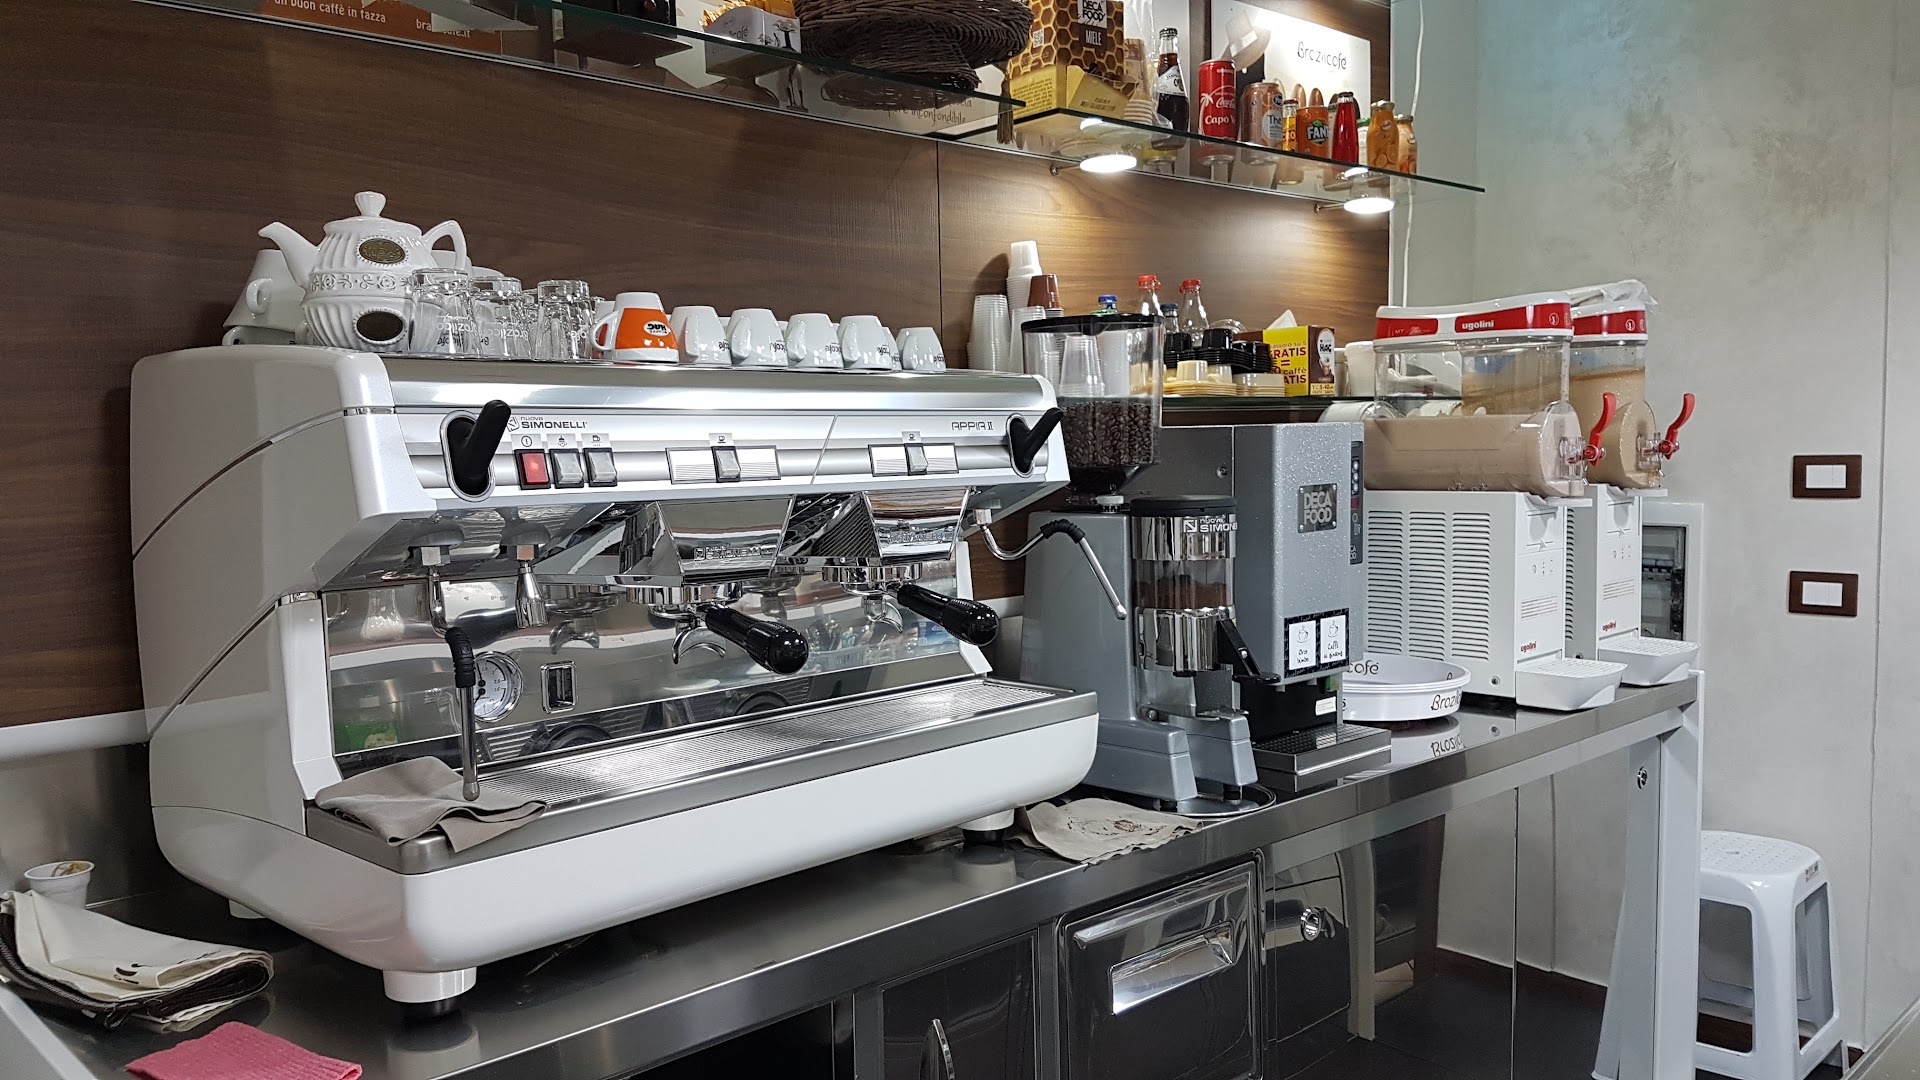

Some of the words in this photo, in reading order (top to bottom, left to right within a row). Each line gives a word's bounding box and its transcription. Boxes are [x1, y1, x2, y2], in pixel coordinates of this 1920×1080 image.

[290, 0, 316, 10] buon
[319, 3, 345, 15] caffè
[347, 6, 357, 17] in
[360, 9, 386, 23] tazza
[1082, 9, 1105, 22] FOOD
[1085, 29, 1102, 46] MIELE
[1204, 115, 1229, 126] Capo
[1461, 319, 1494, 331] ugolini
[1283, 367, 1307, 375] caffè
[521, 421, 586, 429] SIMONELLI
[951, 421, 986, 431] APPIA
[1303, 491, 1333, 509] DECA
[1303, 507, 1333, 526] FOOD
[1602, 620, 1617, 632] ugolini
[1520, 641, 1537, 653] ugolini
